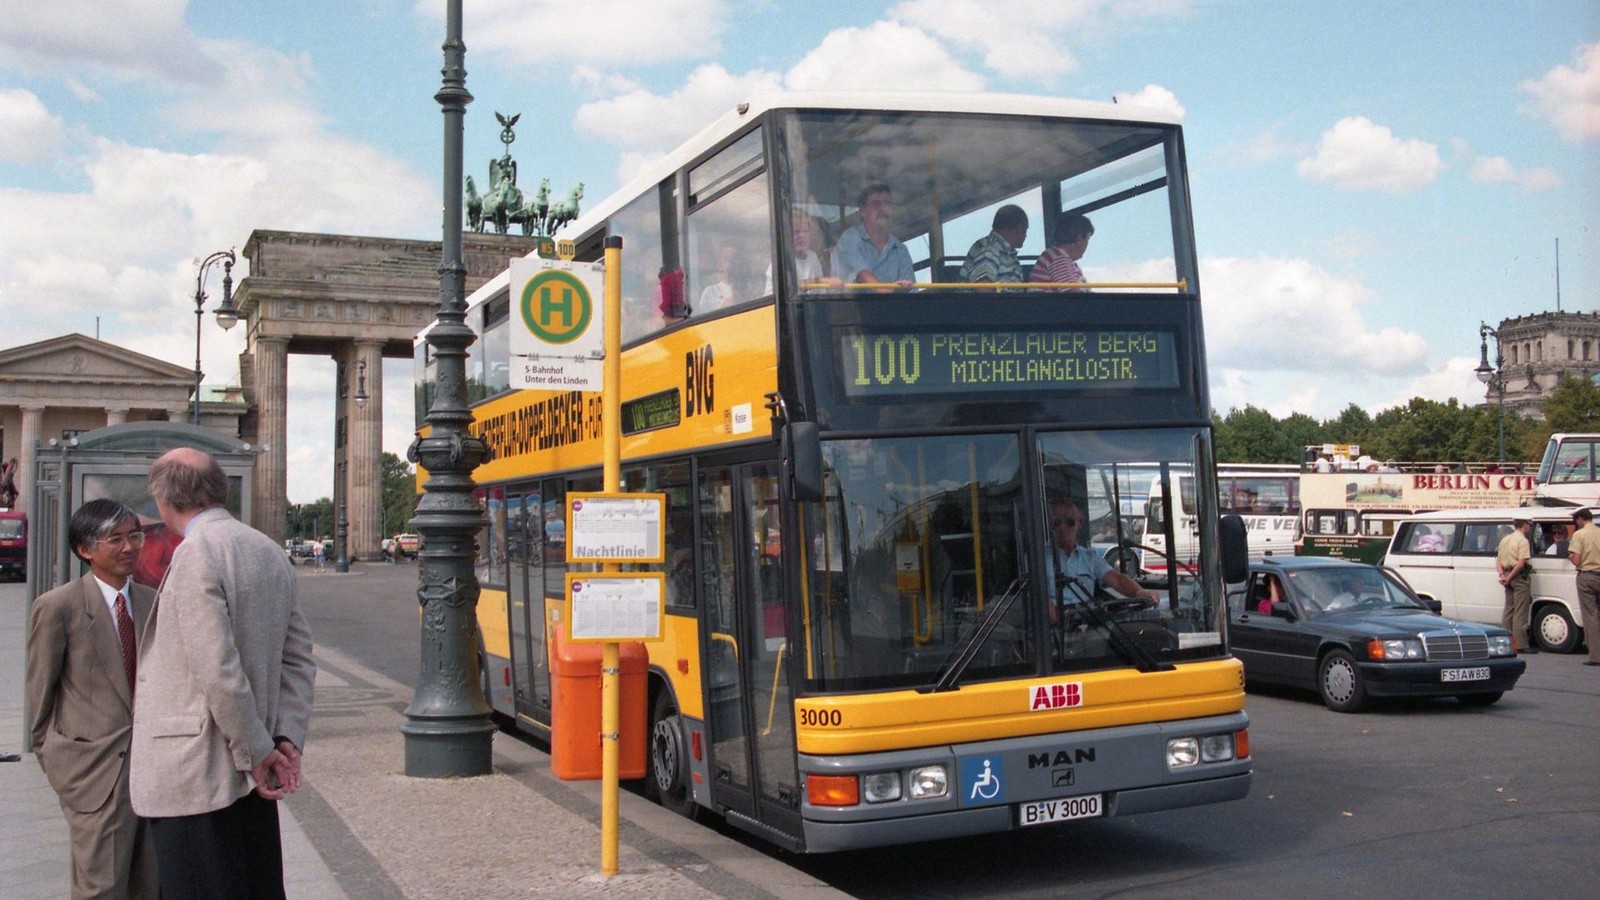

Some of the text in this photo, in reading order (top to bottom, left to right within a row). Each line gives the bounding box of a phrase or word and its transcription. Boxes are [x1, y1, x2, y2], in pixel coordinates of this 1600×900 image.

[558, 243, 574, 256] 100
[540, 287, 573, 327] H
[931, 331, 1157, 356] PRENZLAUER BERG
[525, 365, 564, 374] S-Bahnhof
[853, 334, 921, 385] 100
[951, 357, 1138, 384] MICHELANGELOSTR.
[525, 375, 589, 385] Unter den Linden
[685, 343, 715, 419] BVG
[1413, 474, 1491, 490] BERLIN
[576, 545, 646, 558] Nachtlinie
[1032, 683, 1081, 710] ABB
[800, 708, 842, 727] 3000
[1028, 747, 1096, 770] MAN
[1060, 797, 1098, 818] 3000
